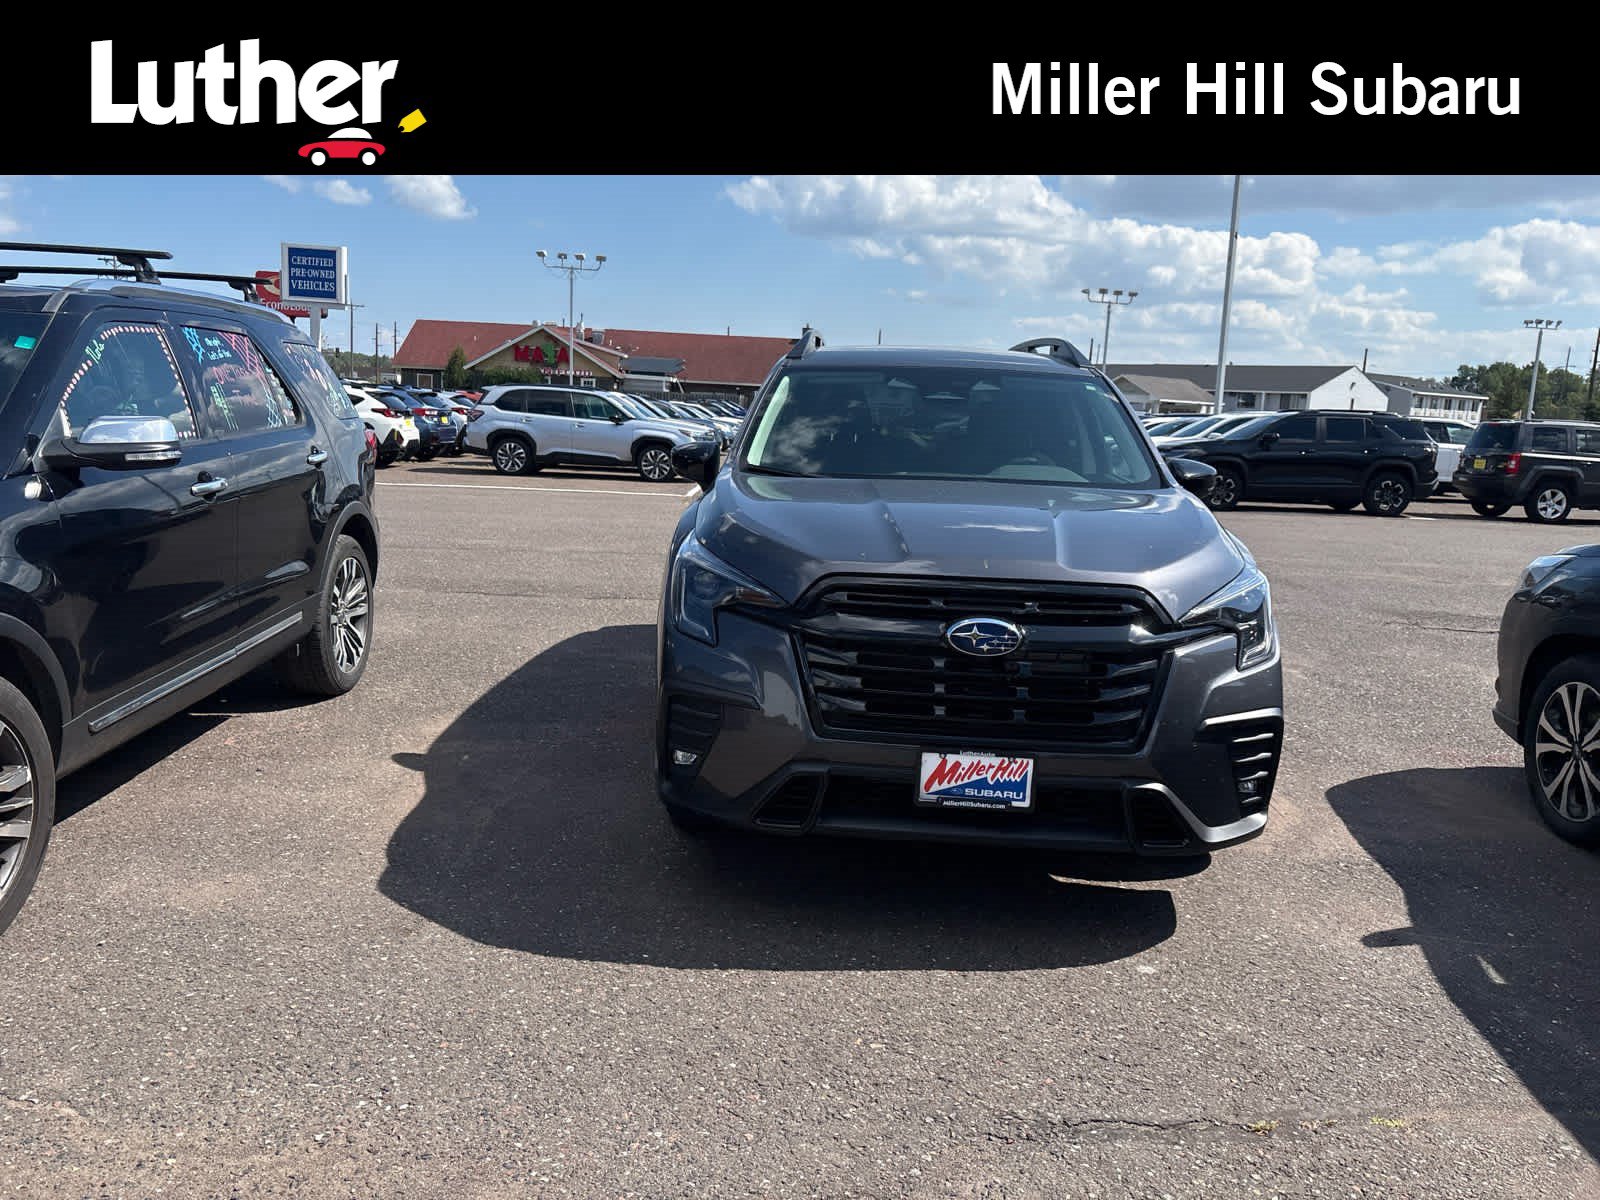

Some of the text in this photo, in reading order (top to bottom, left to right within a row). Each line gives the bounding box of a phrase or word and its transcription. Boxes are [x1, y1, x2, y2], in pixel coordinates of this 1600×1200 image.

[291, 255, 334, 267] CERTIFIED
[290, 267, 335, 279] PRE-OWNED
[290, 279, 335, 292] VEHICLES
[923, 757, 1030, 793] Miller Hill
[964, 788, 1024, 800] SUBARU
